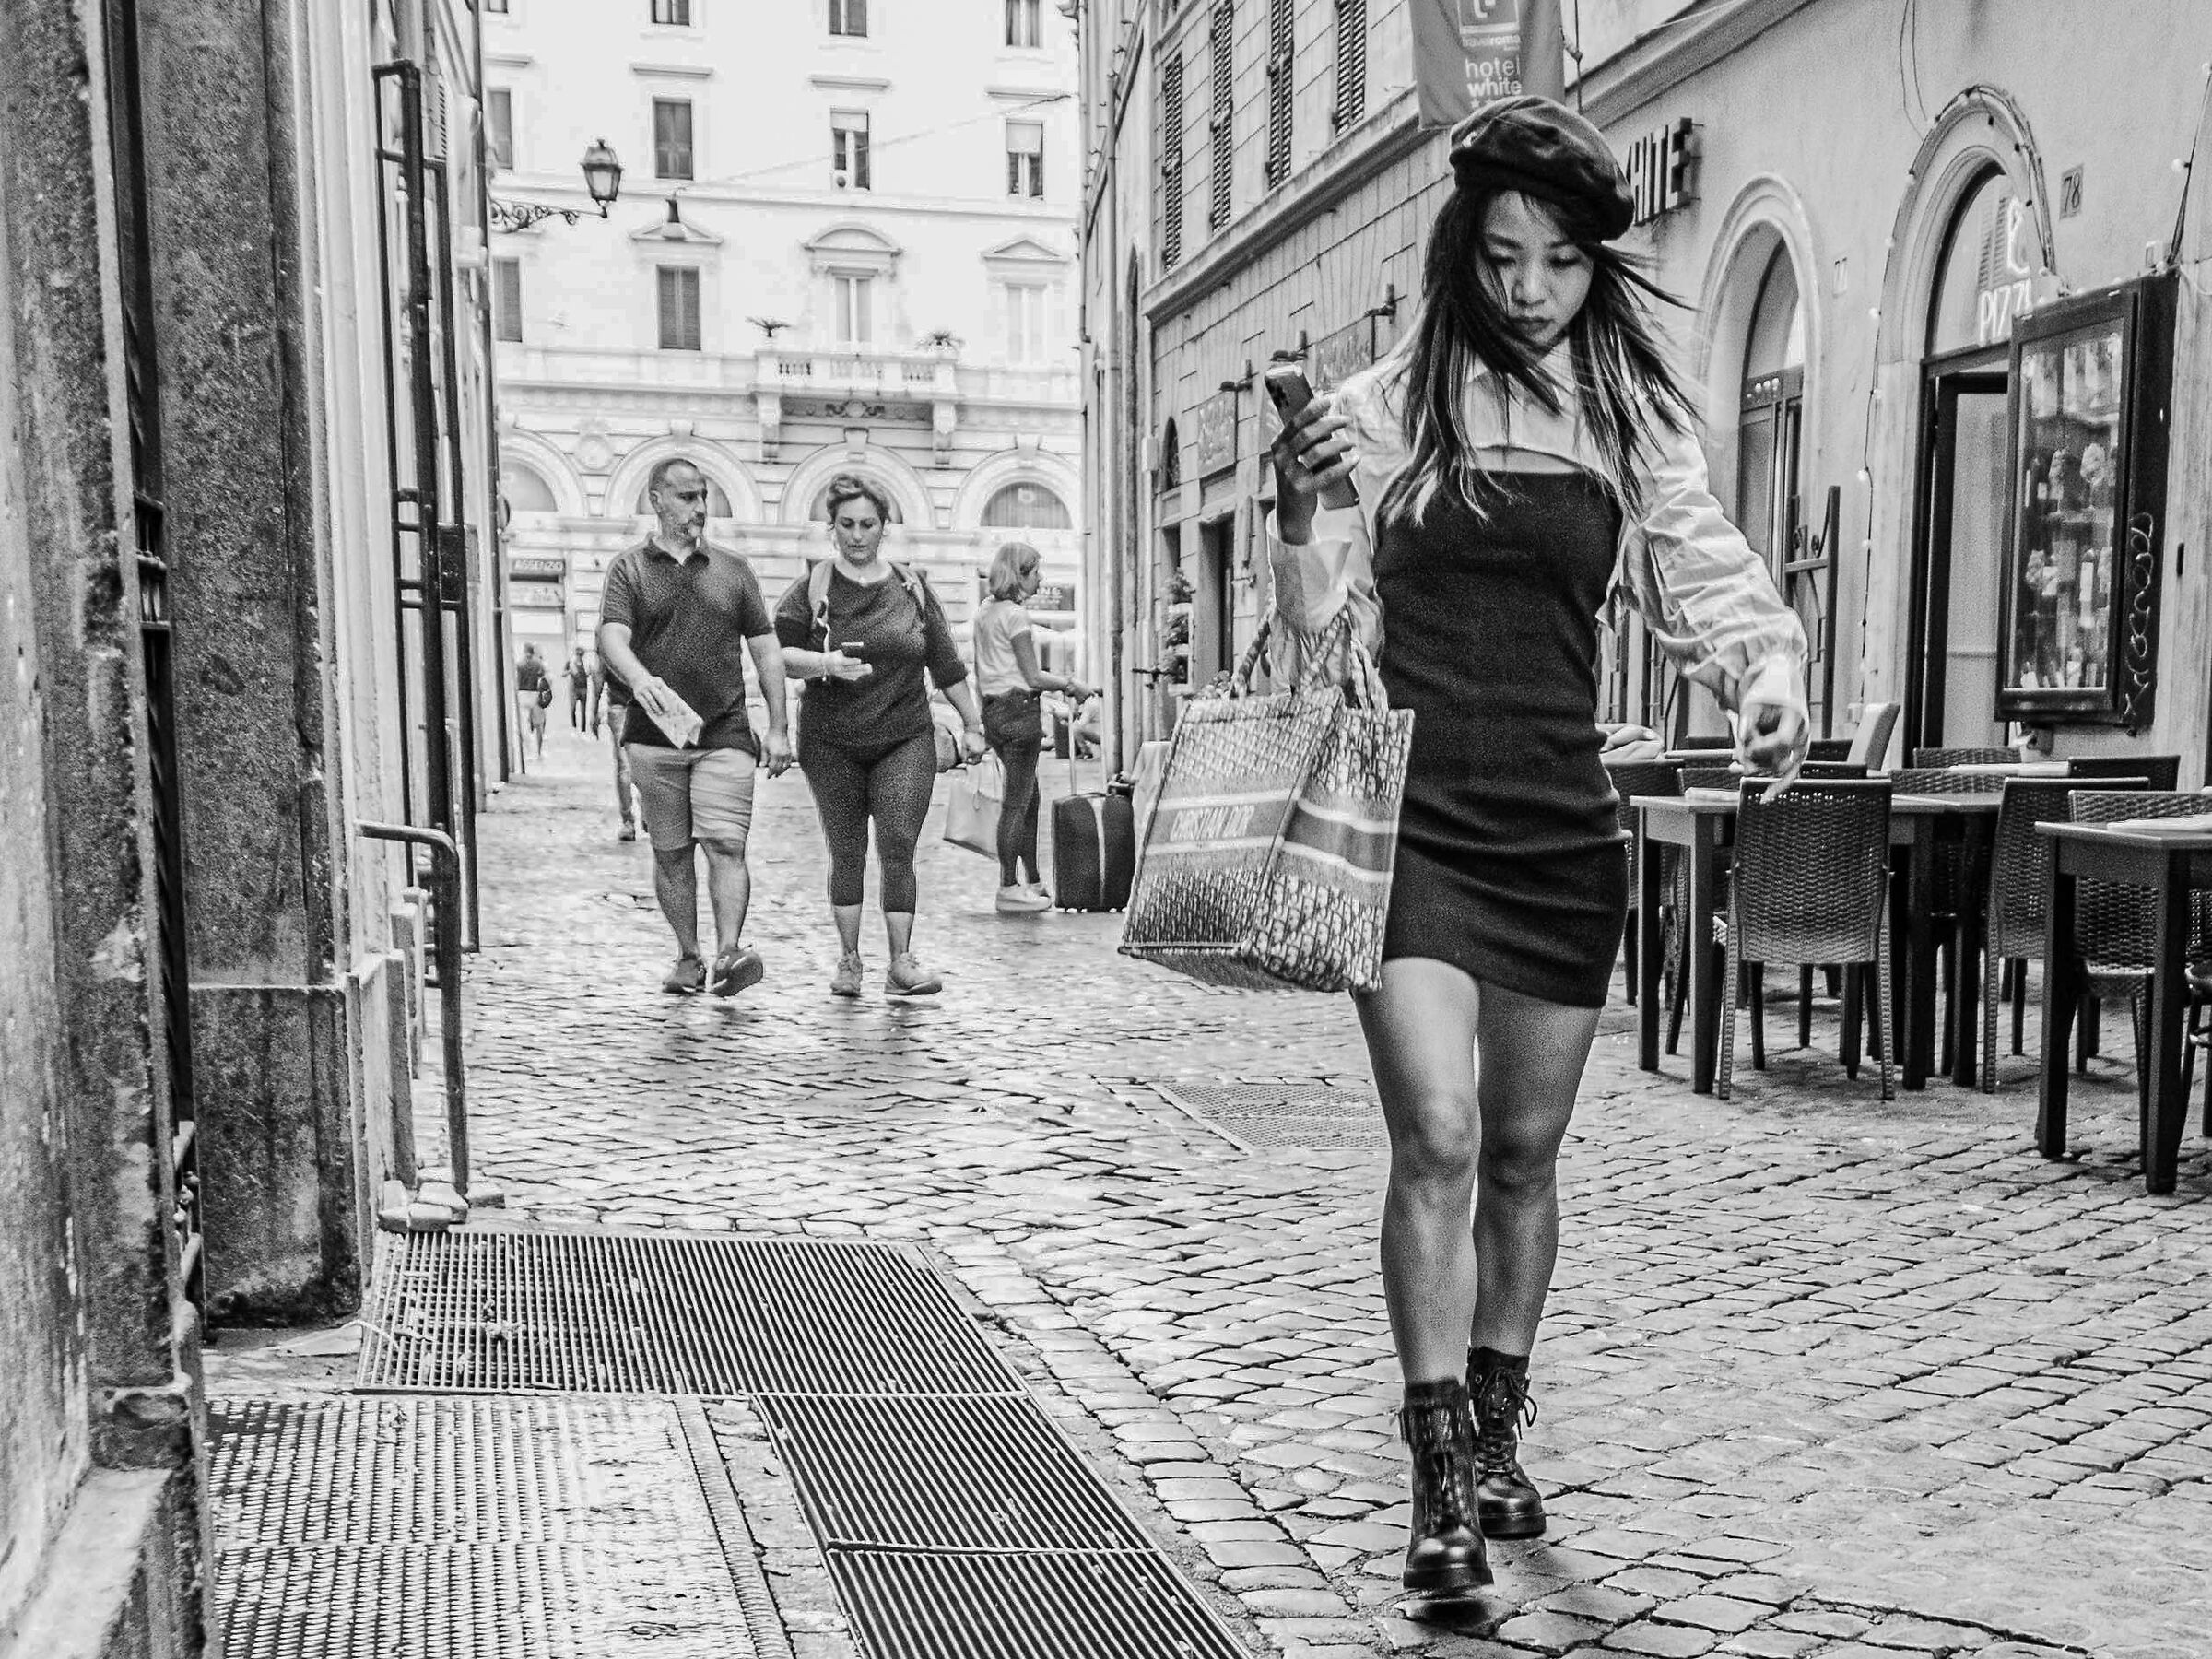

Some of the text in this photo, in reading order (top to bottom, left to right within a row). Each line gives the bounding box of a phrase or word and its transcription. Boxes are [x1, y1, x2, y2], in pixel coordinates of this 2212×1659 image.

[1465, 55, 1520, 78] hotel
[1466, 77, 1522, 97] white
[2062, 172, 2080, 212] 78
